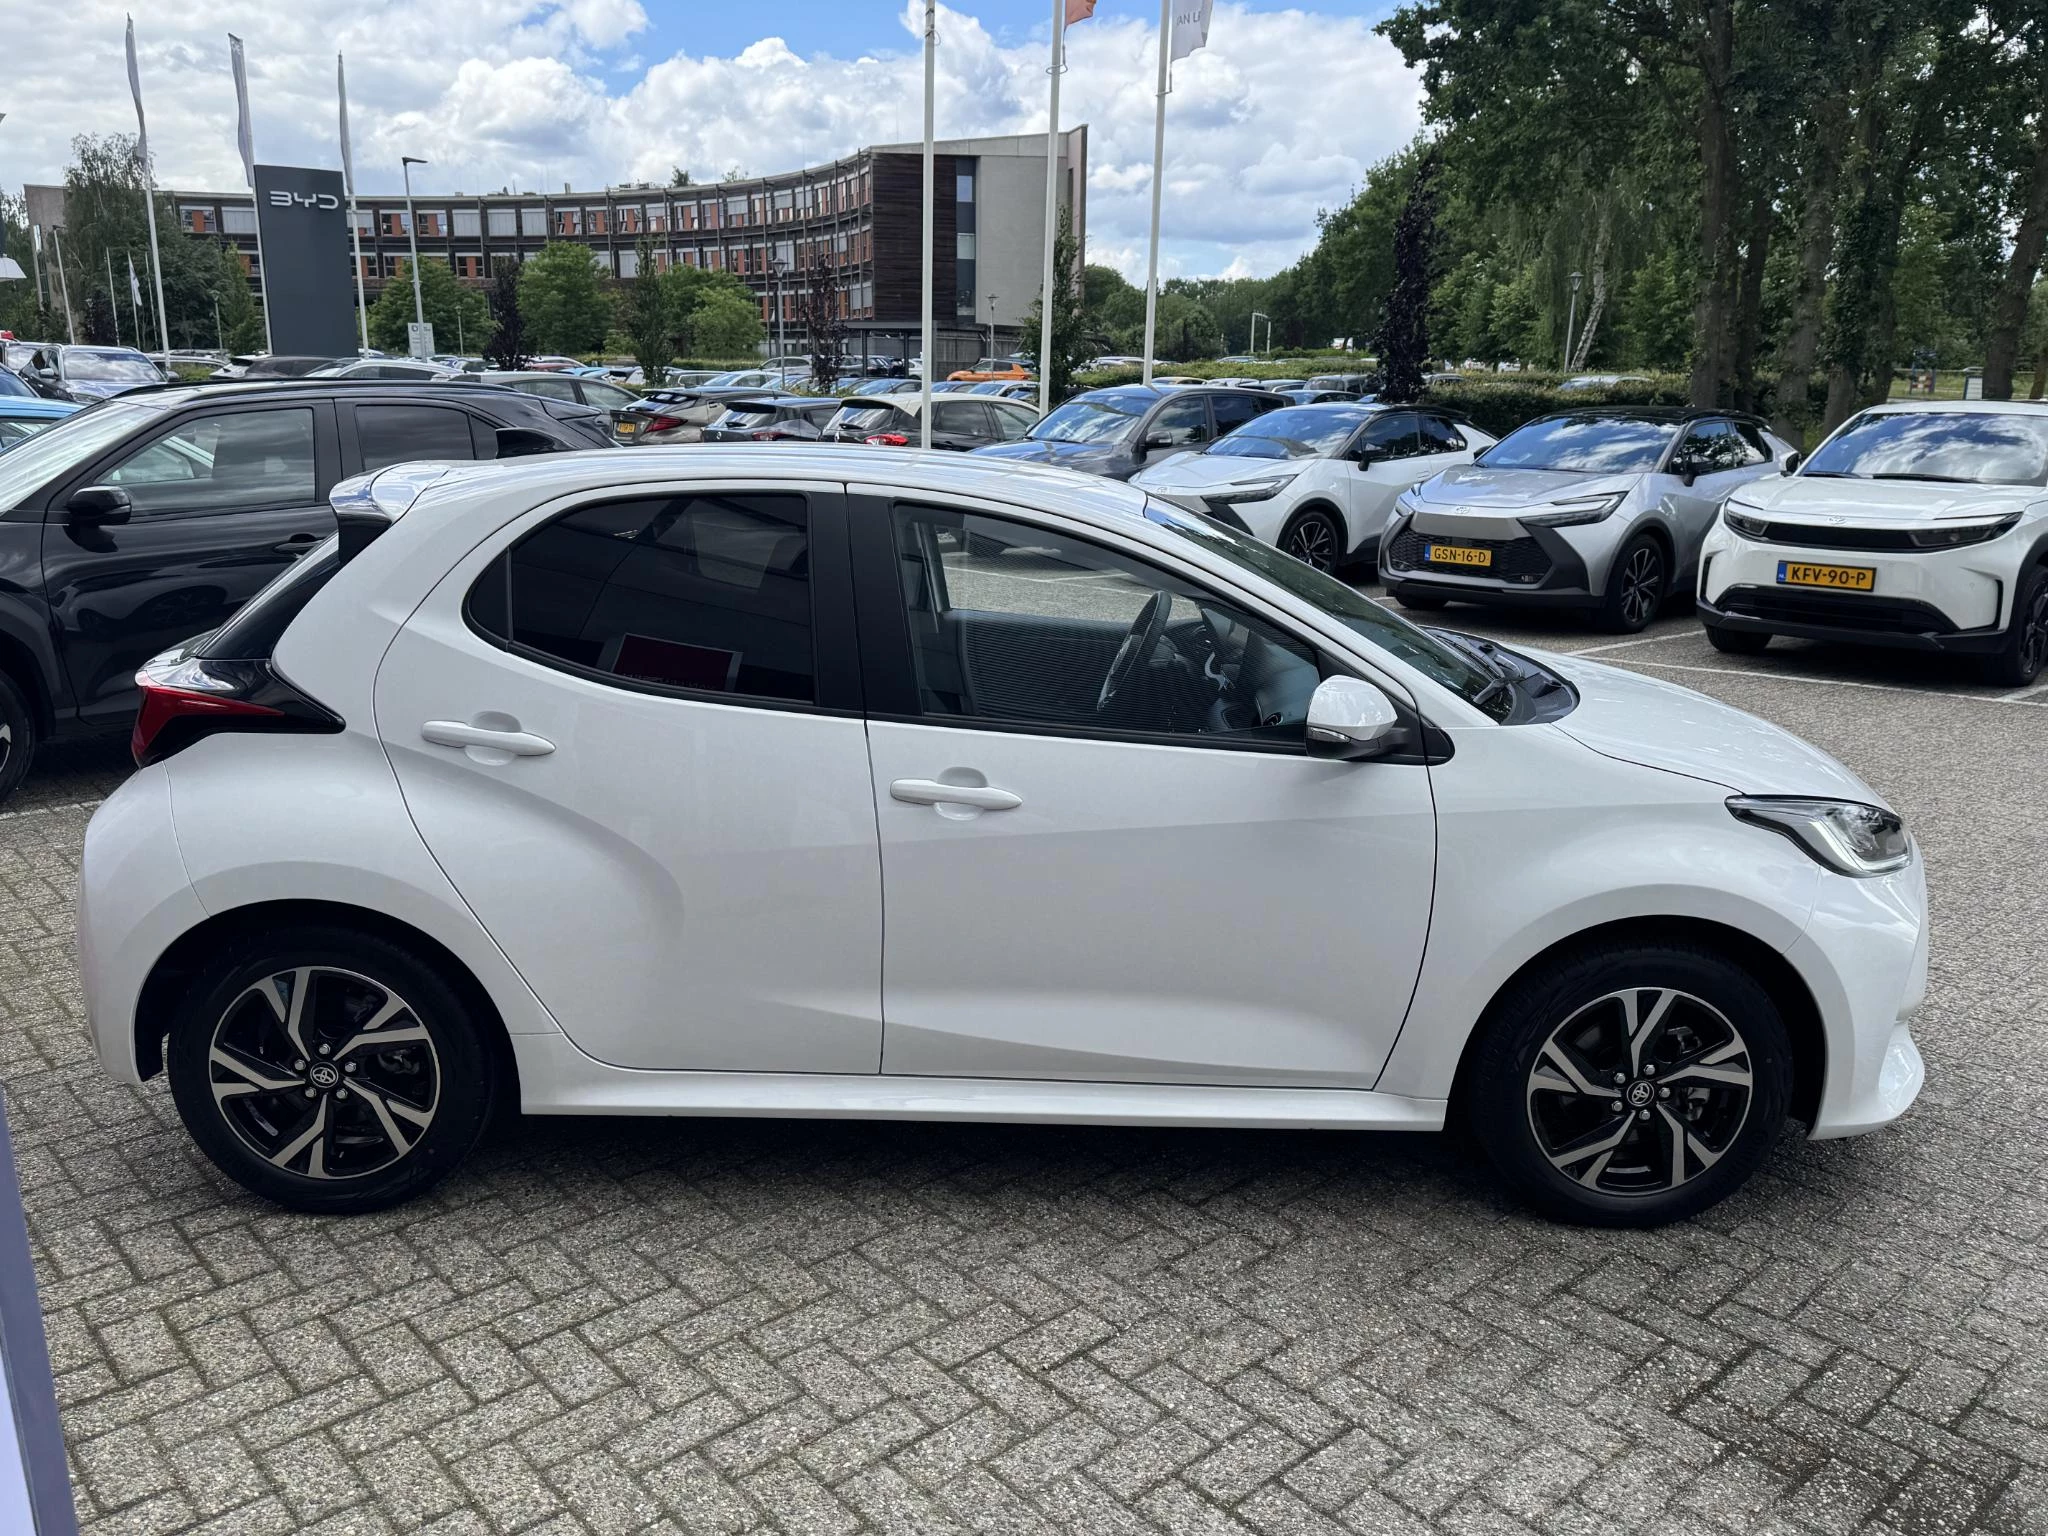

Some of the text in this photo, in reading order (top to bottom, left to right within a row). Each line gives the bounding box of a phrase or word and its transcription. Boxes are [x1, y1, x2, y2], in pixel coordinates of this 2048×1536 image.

[270, 190, 339, 210] BYD
[1434, 547, 1486, 564] GSN-16-D
[1791, 566, 1867, 586] KFV-90-P
